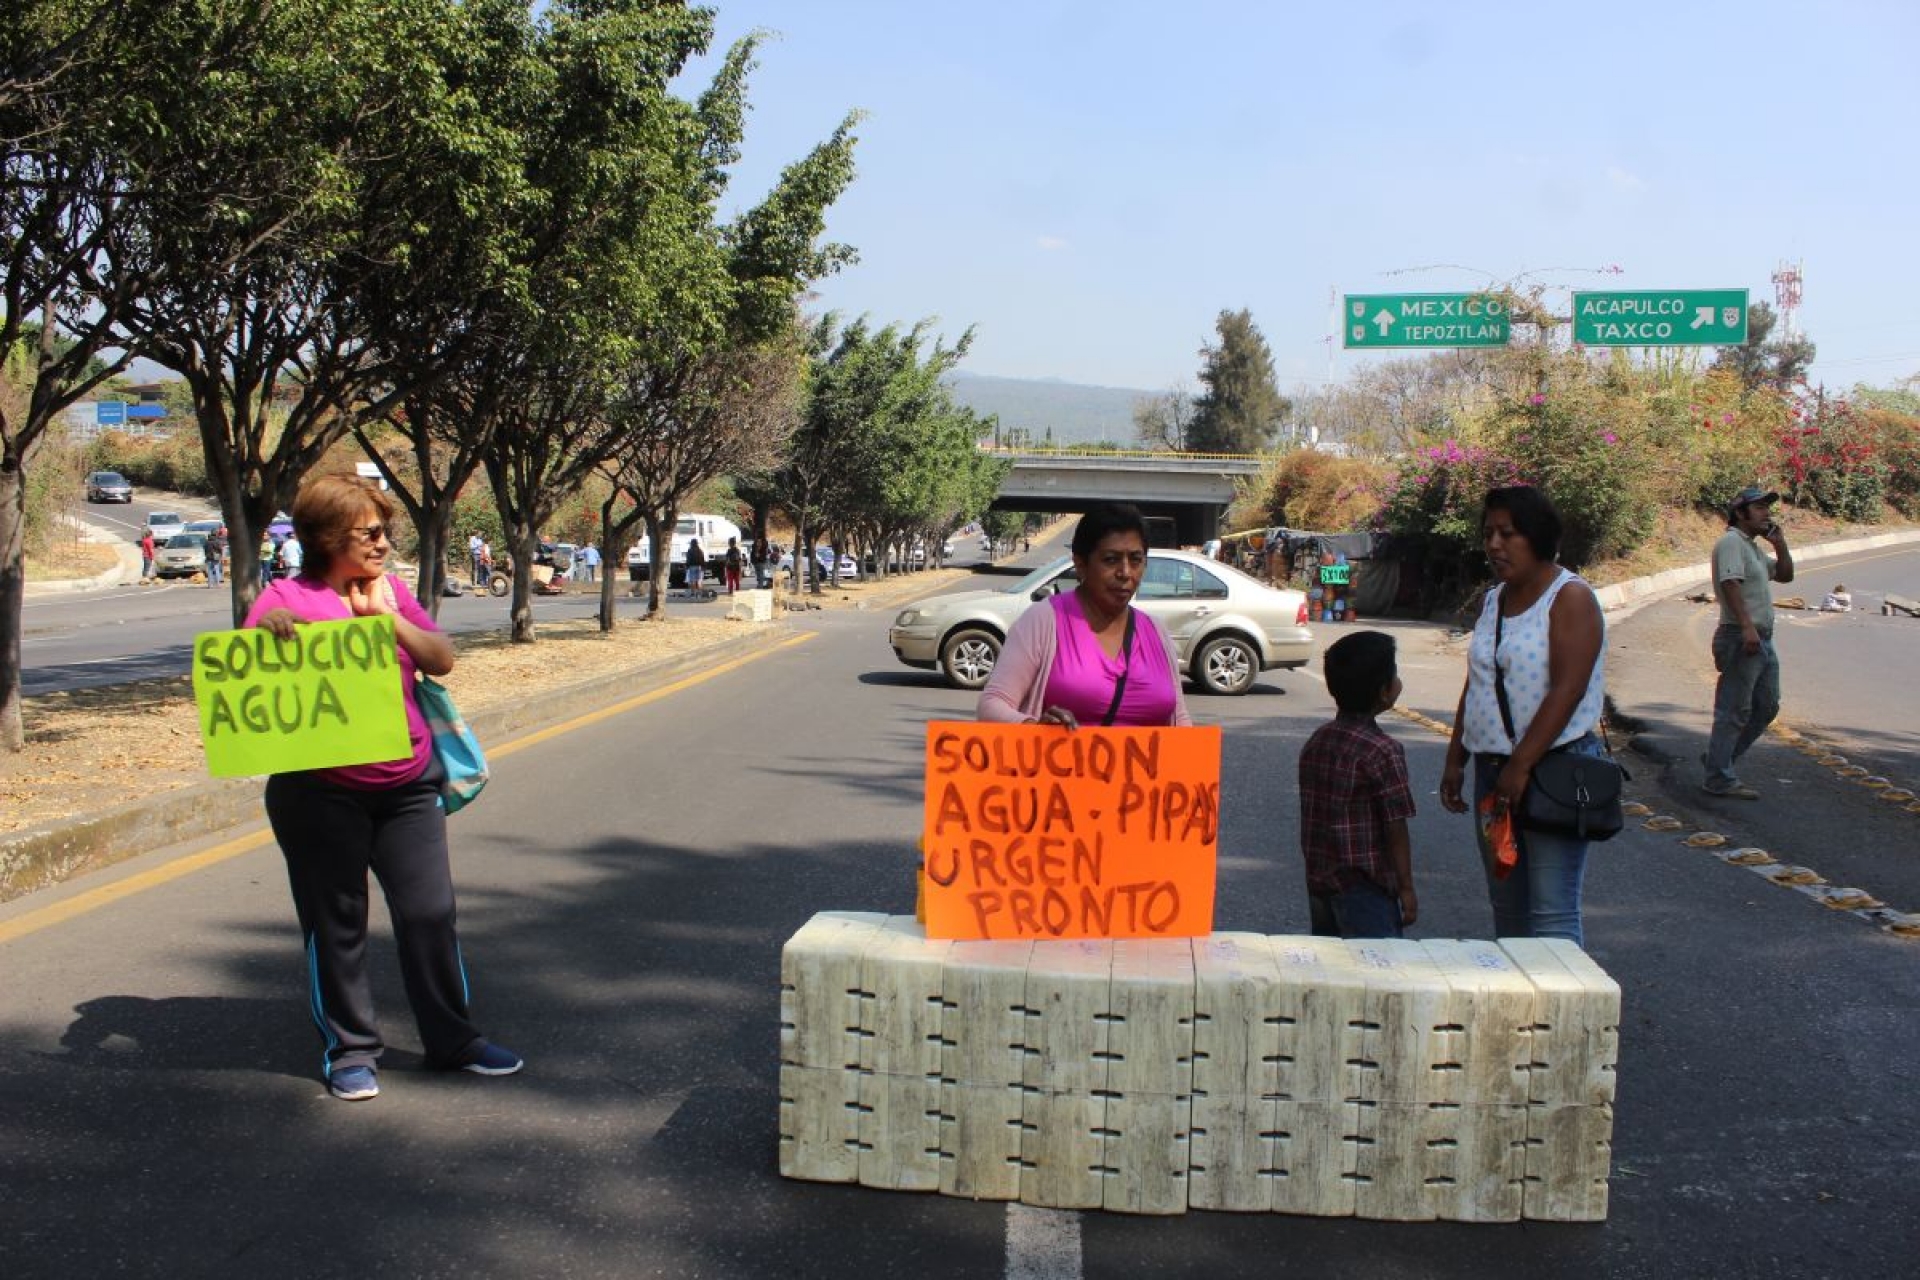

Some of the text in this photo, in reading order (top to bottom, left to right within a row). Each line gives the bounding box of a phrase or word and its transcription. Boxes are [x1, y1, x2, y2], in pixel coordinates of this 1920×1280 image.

[1401, 301, 1502, 316] MEXICO
[1405, 325, 1500, 340] TEPOZTLAN
[1582, 300, 1684, 315] ACAPULCO
[1594, 323, 1672, 338] TAXCO
[200, 618, 399, 682] SOLUCION
[209, 676, 349, 736] AGUA
[934, 731, 1160, 784] SOLUCION
[1118, 781, 1218, 846] PIPAS
[928, 831, 1103, 888] URGEN
[967, 880, 1181, 940] PRONTO
